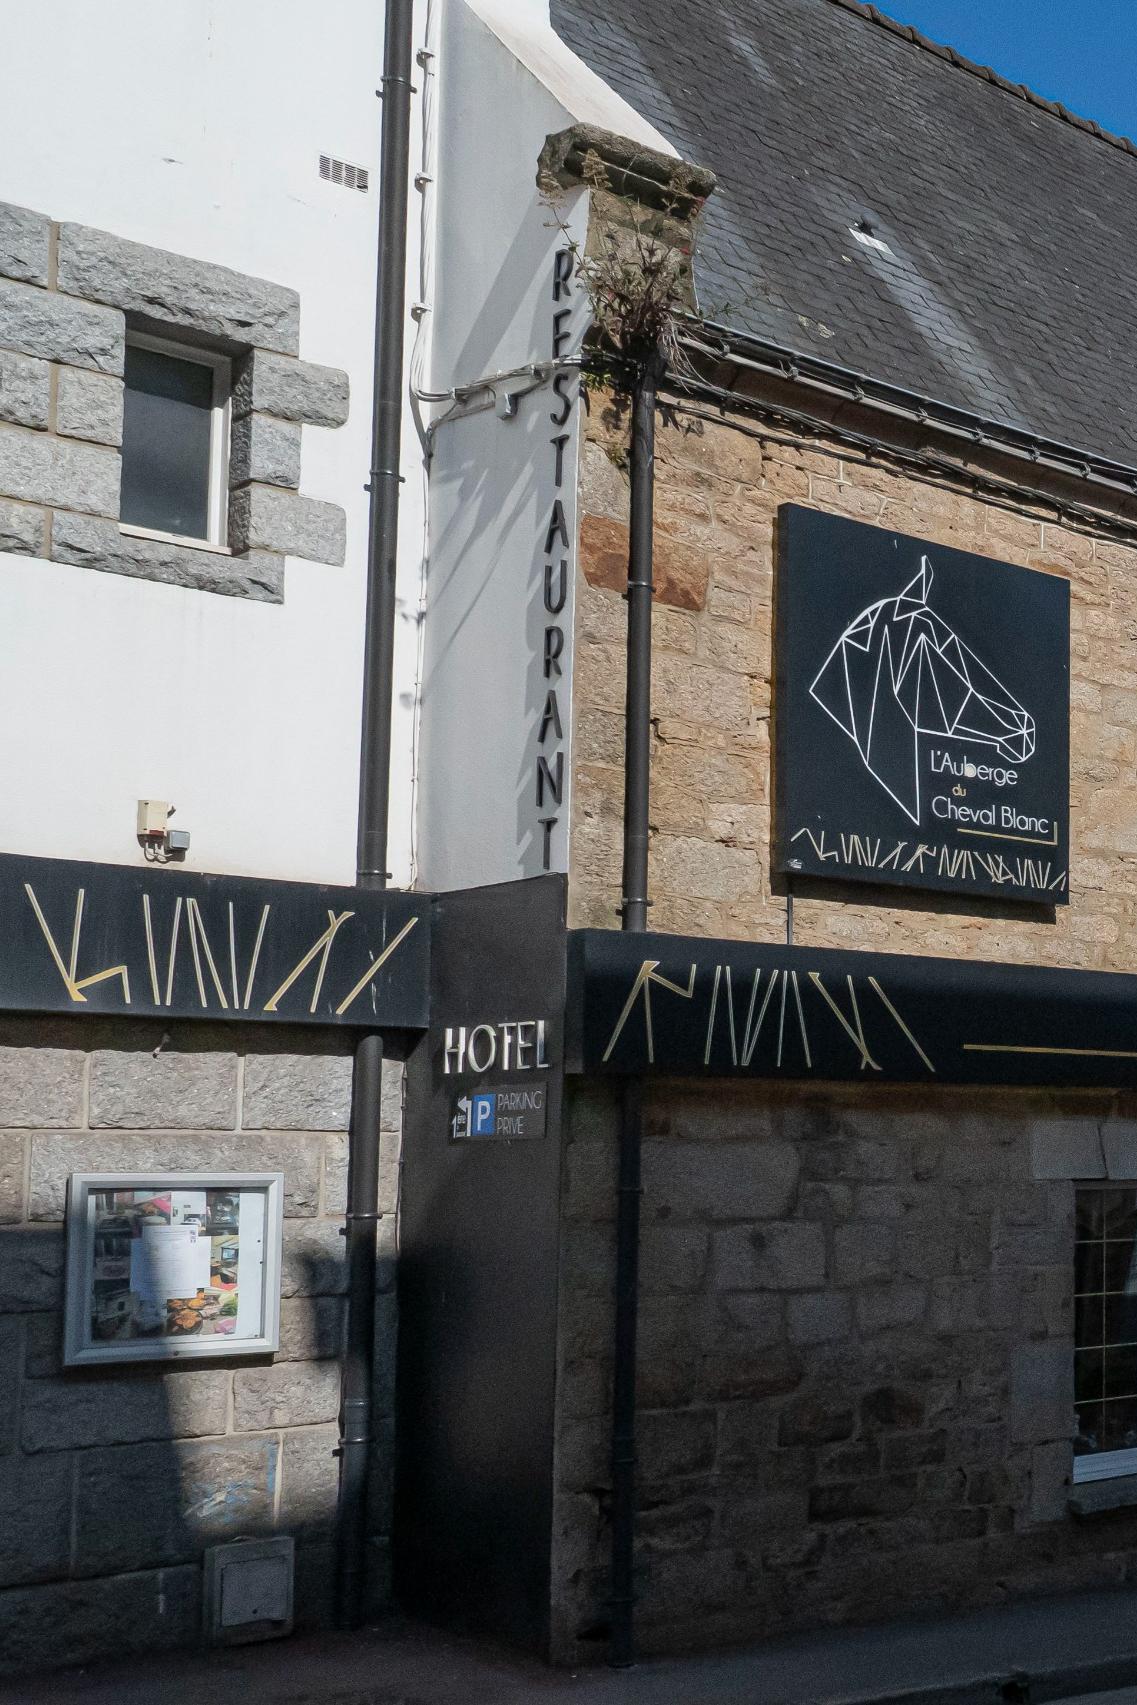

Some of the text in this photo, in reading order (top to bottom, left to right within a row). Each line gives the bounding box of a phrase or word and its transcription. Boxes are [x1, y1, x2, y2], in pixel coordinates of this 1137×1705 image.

[536, 249, 573, 869] RESTAURANT
[931, 750, 1018, 786] L'Auberge
[952, 784, 966, 796] du
[932, 796, 1048, 833] Cheval Blanc
[444, 1020, 549, 1073] HOTEL
[477, 1101, 490, 1130] P
[497, 1091, 542, 1111] PARKING
